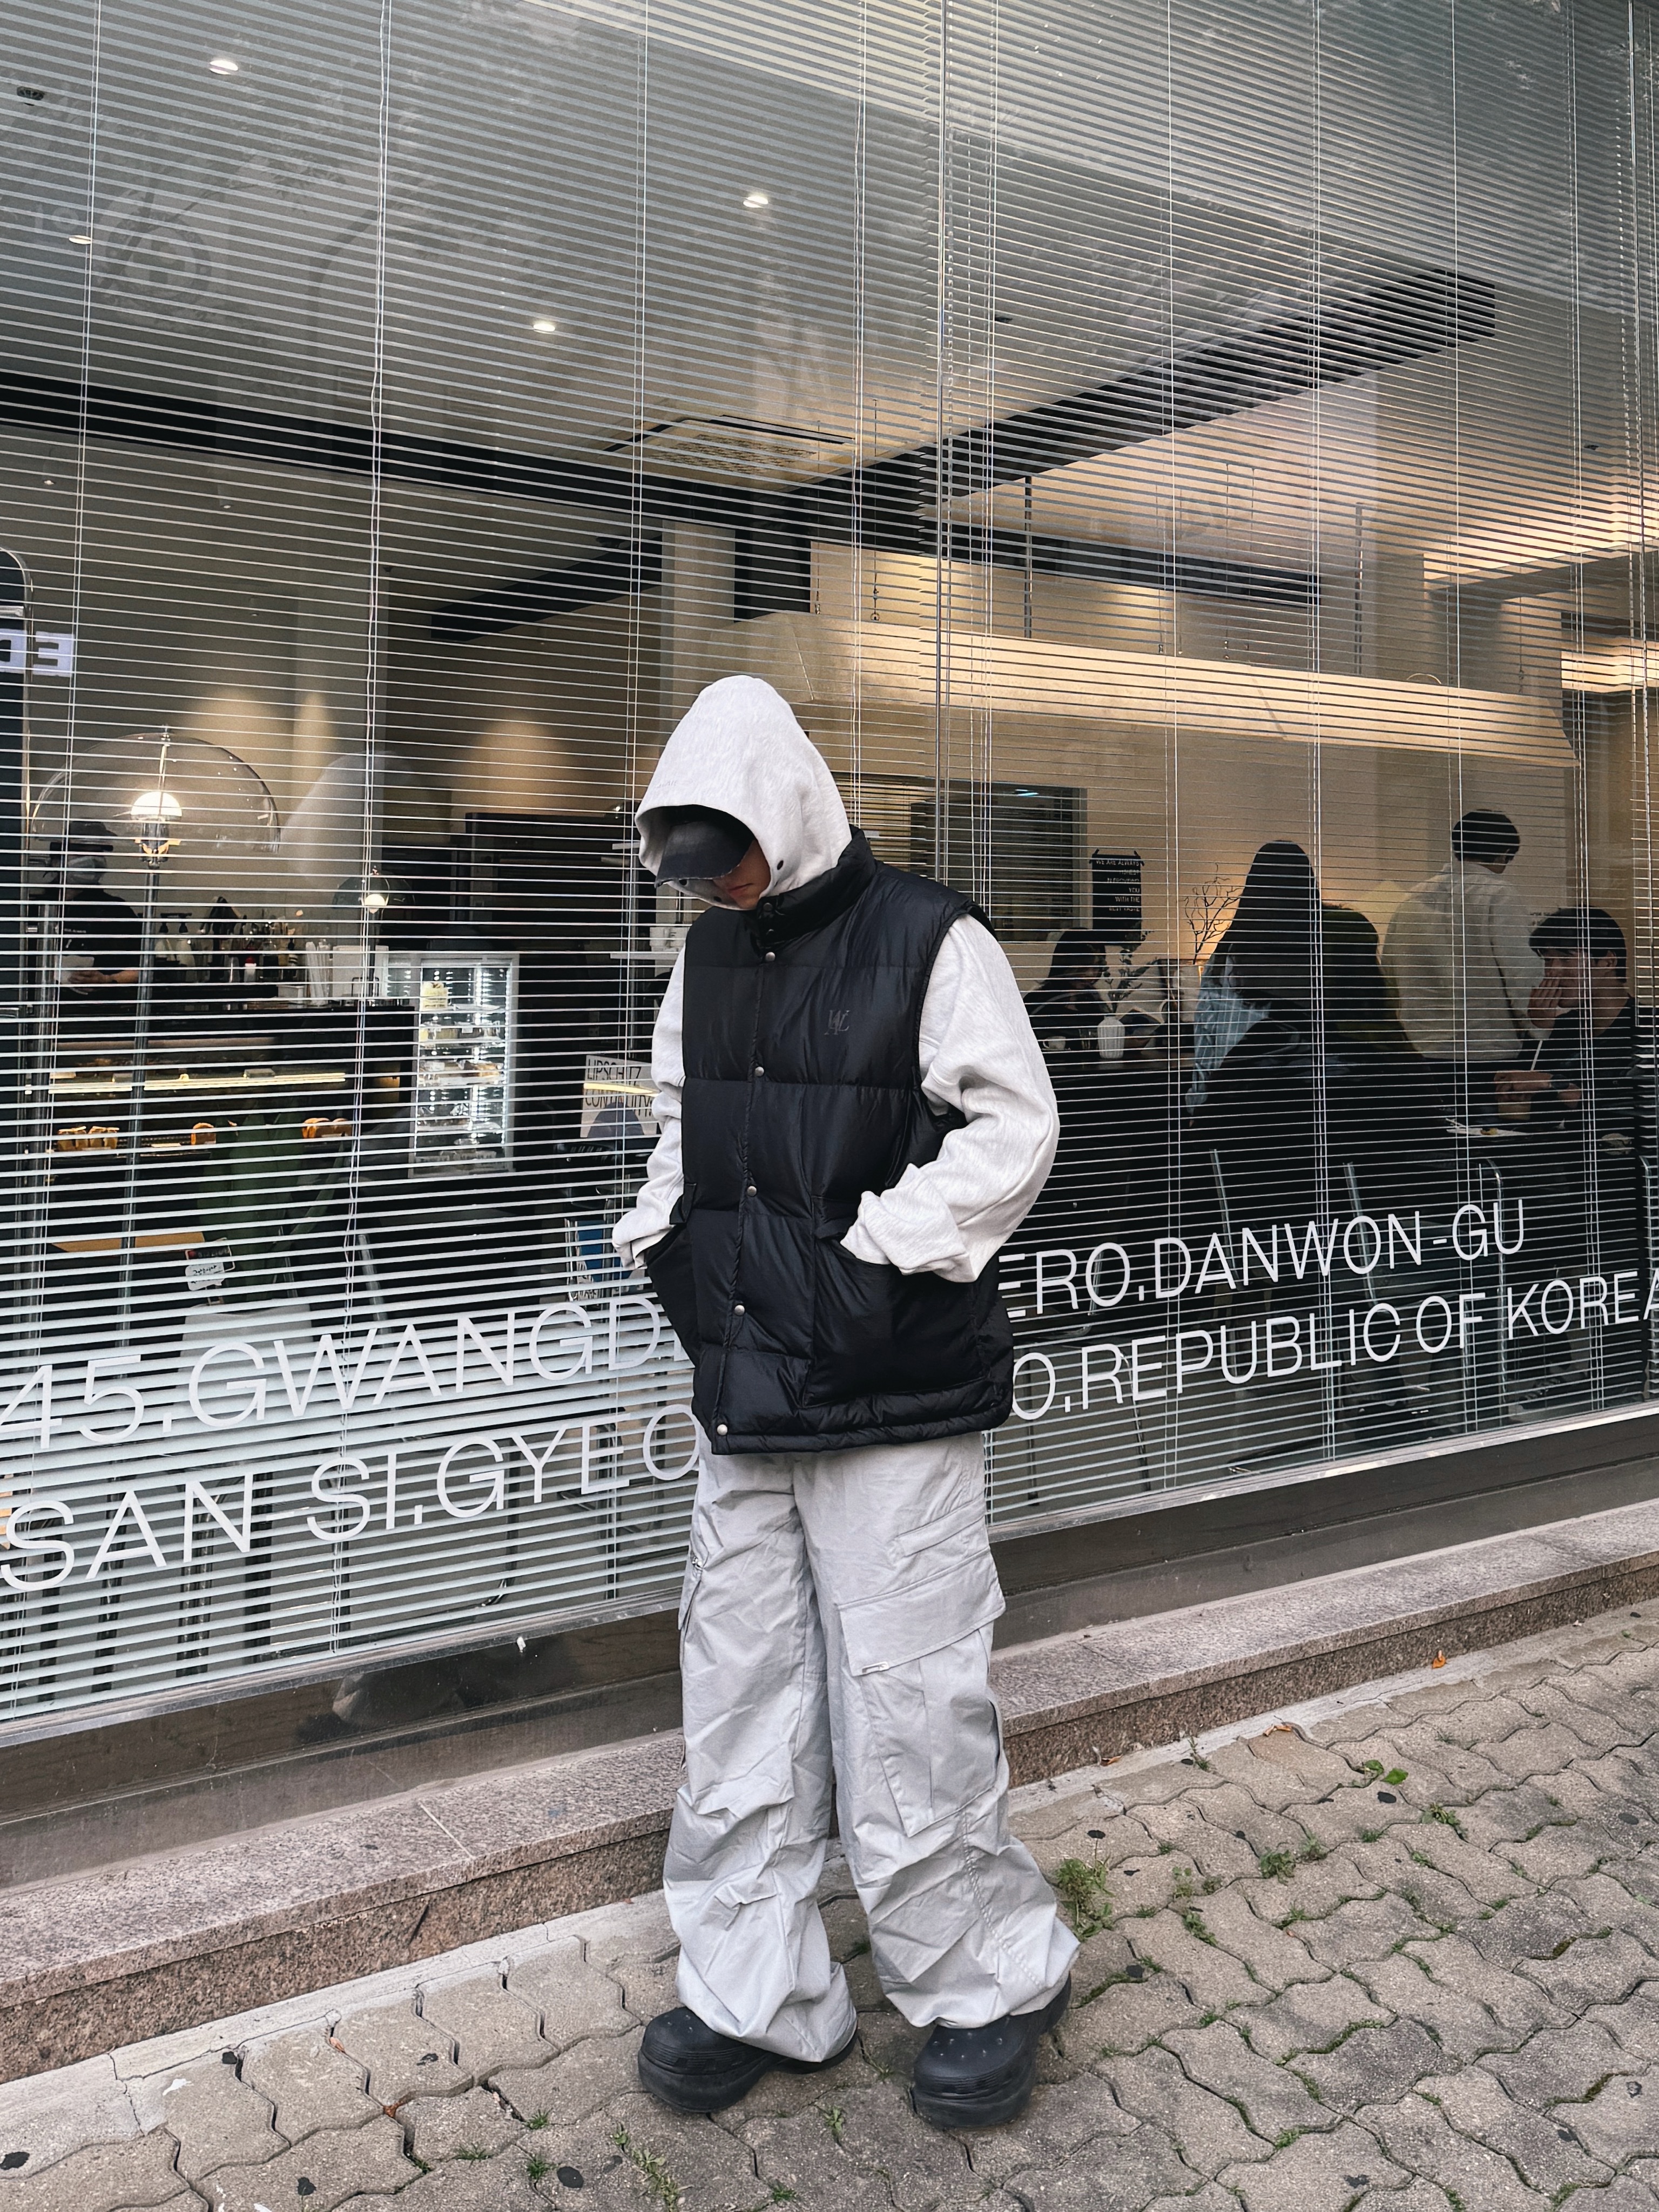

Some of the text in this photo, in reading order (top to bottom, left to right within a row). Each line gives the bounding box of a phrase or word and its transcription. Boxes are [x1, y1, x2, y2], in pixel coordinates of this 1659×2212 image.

[1416, 1293, 1486, 1353] OF
[1507, 1268, 1659, 1340] KOREA
[0, 1297, 689, 1449] 45.GWANGD
